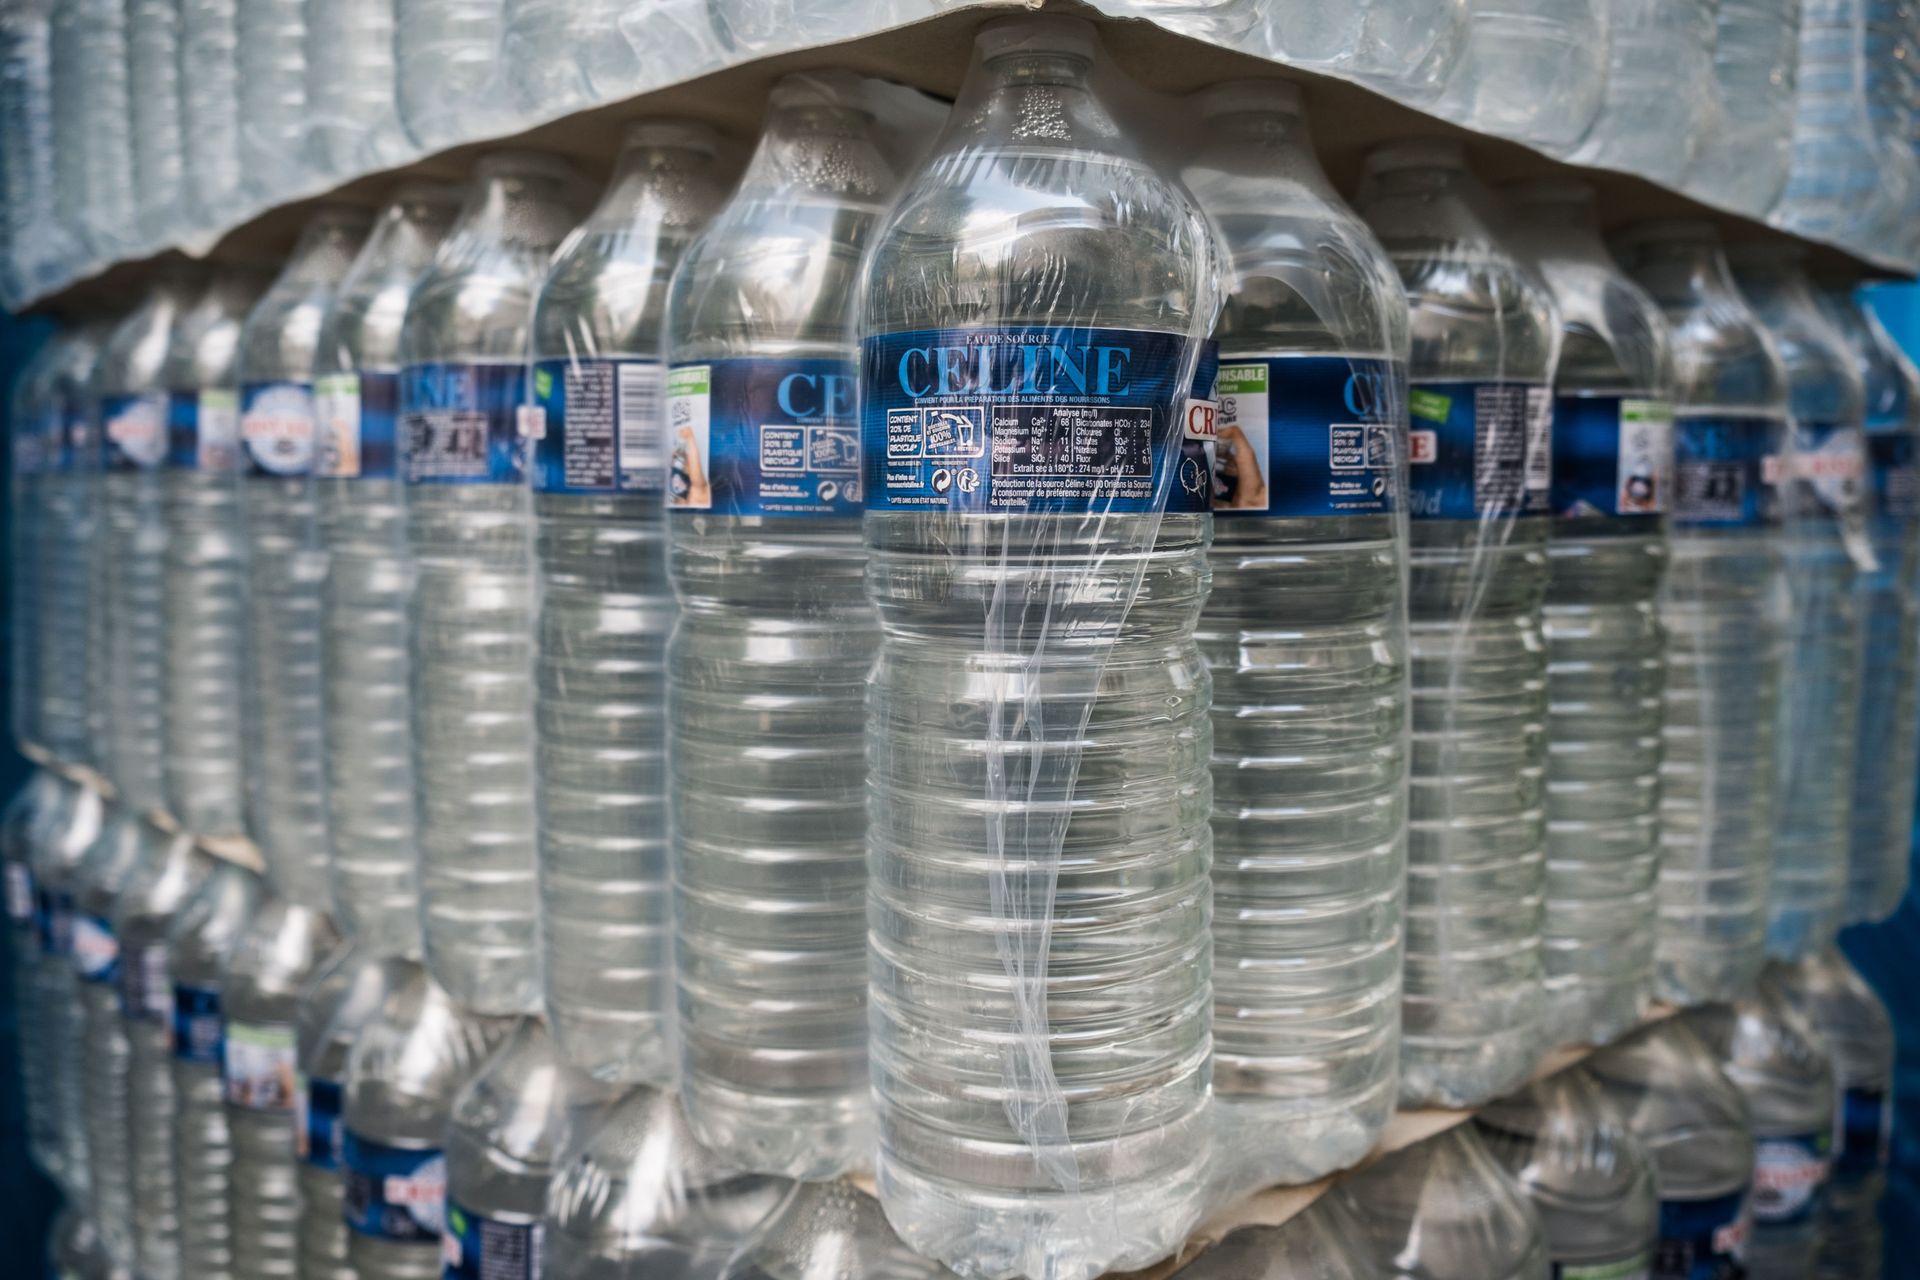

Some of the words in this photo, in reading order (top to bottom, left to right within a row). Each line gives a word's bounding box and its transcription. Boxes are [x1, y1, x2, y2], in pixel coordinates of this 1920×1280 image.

[966, 335, 988, 345] EAU
[990, 335, 1003, 344] DE
[1006, 333, 1050, 344] SOURCE
[899, 345, 1131, 398] CELINE
[1053, 408, 1080, 419] Analyse
[1081, 408, 1098, 419] (mg/l)
[889, 415, 918, 424] CONTIENT
[994, 417, 1019, 426] Calcium
[1060, 418, 1070, 426] 68
[1076, 418, 1113, 427] Bicarbonates
[889, 425, 903, 433] 20%
[764, 431, 800, 440] CONTIENT
[889, 434, 922, 443] PLASTIQUE
[1060, 437, 1069, 445] 11
[993, 446, 1026, 454] Potassium
[1060, 454, 1070, 462] 40
[1076, 455, 1091, 463] Fluor
[1013, 464, 1034, 473] Extrait
[1035, 465, 1048, 473] sec
[1048, 464, 1053, 473] à
[1054, 464, 1074, 473] 180°C
[1079, 465, 1091, 473] 274
[1091, 465, 1105, 474] mg/l
[1110, 465, 1119, 474] pH
[1125, 465, 1135, 474] 7,5
[991, 479, 1026, 488] Production
[1026, 480, 1035, 488] de
[1035, 480, 1042, 488] la
[1065, 479, 1085, 488] Céline
[1085, 480, 1103, 488] 45100
[1128, 480, 1133, 488] la
[1133, 480, 1152, 489] Source
[1036, 489, 1045, 497] de
[1045, 488, 1080, 499] préférence
[1098, 489, 1105, 497] la
[999, 498, 1028, 506] bouteille.
